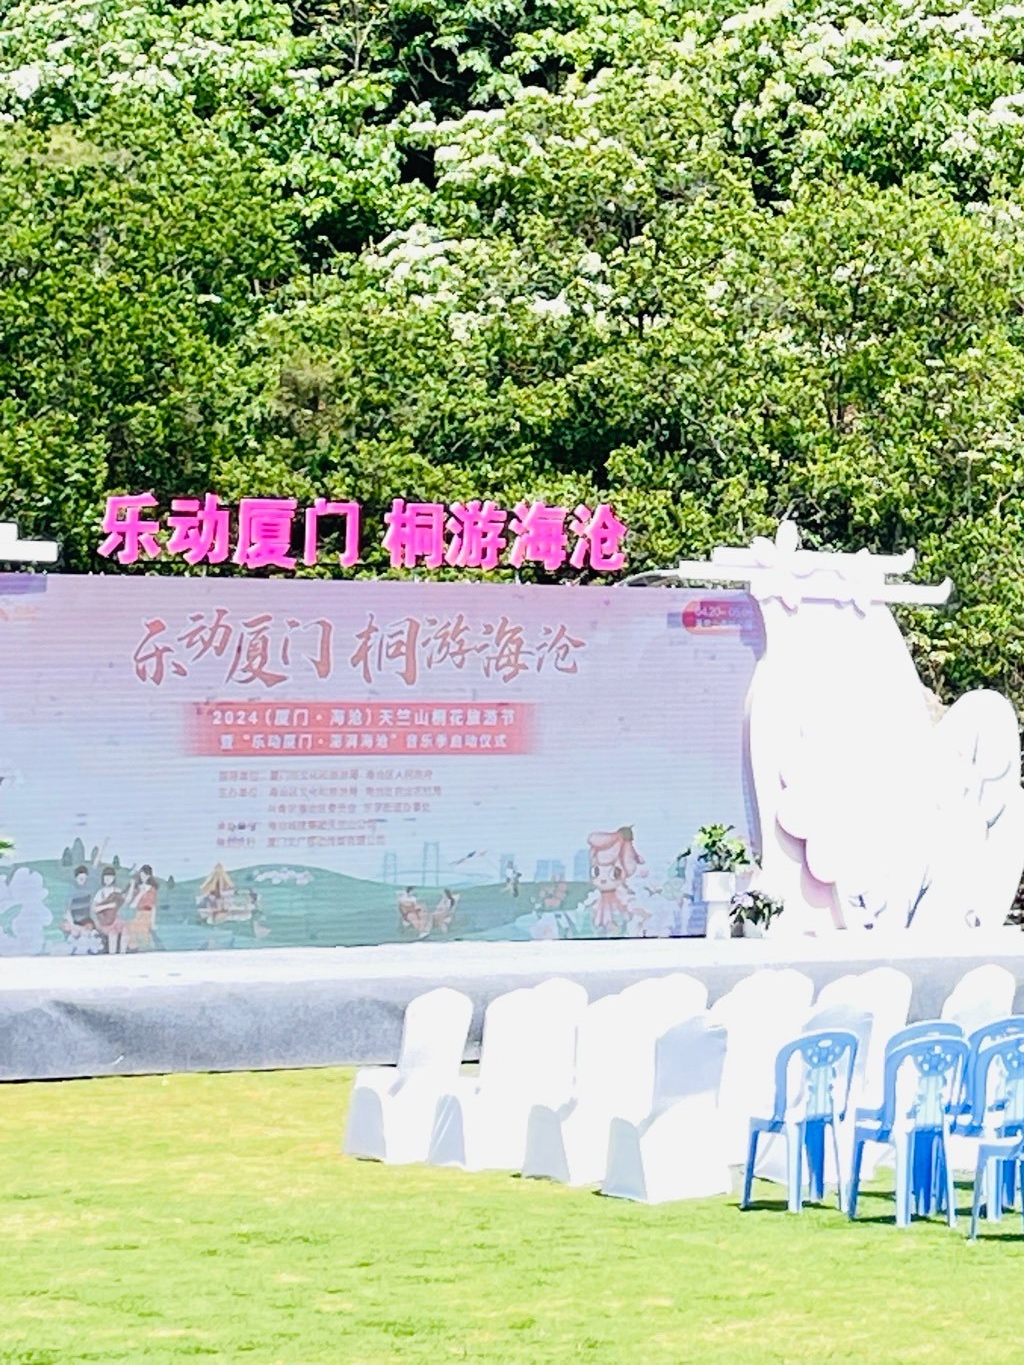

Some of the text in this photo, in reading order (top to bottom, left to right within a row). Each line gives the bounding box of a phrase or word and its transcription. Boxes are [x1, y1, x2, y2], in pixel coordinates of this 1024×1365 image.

[98, 491, 627, 571] 乐动厦门 桐游海沧
[133, 608, 587, 687] 乐动厦门 桐游海沧
